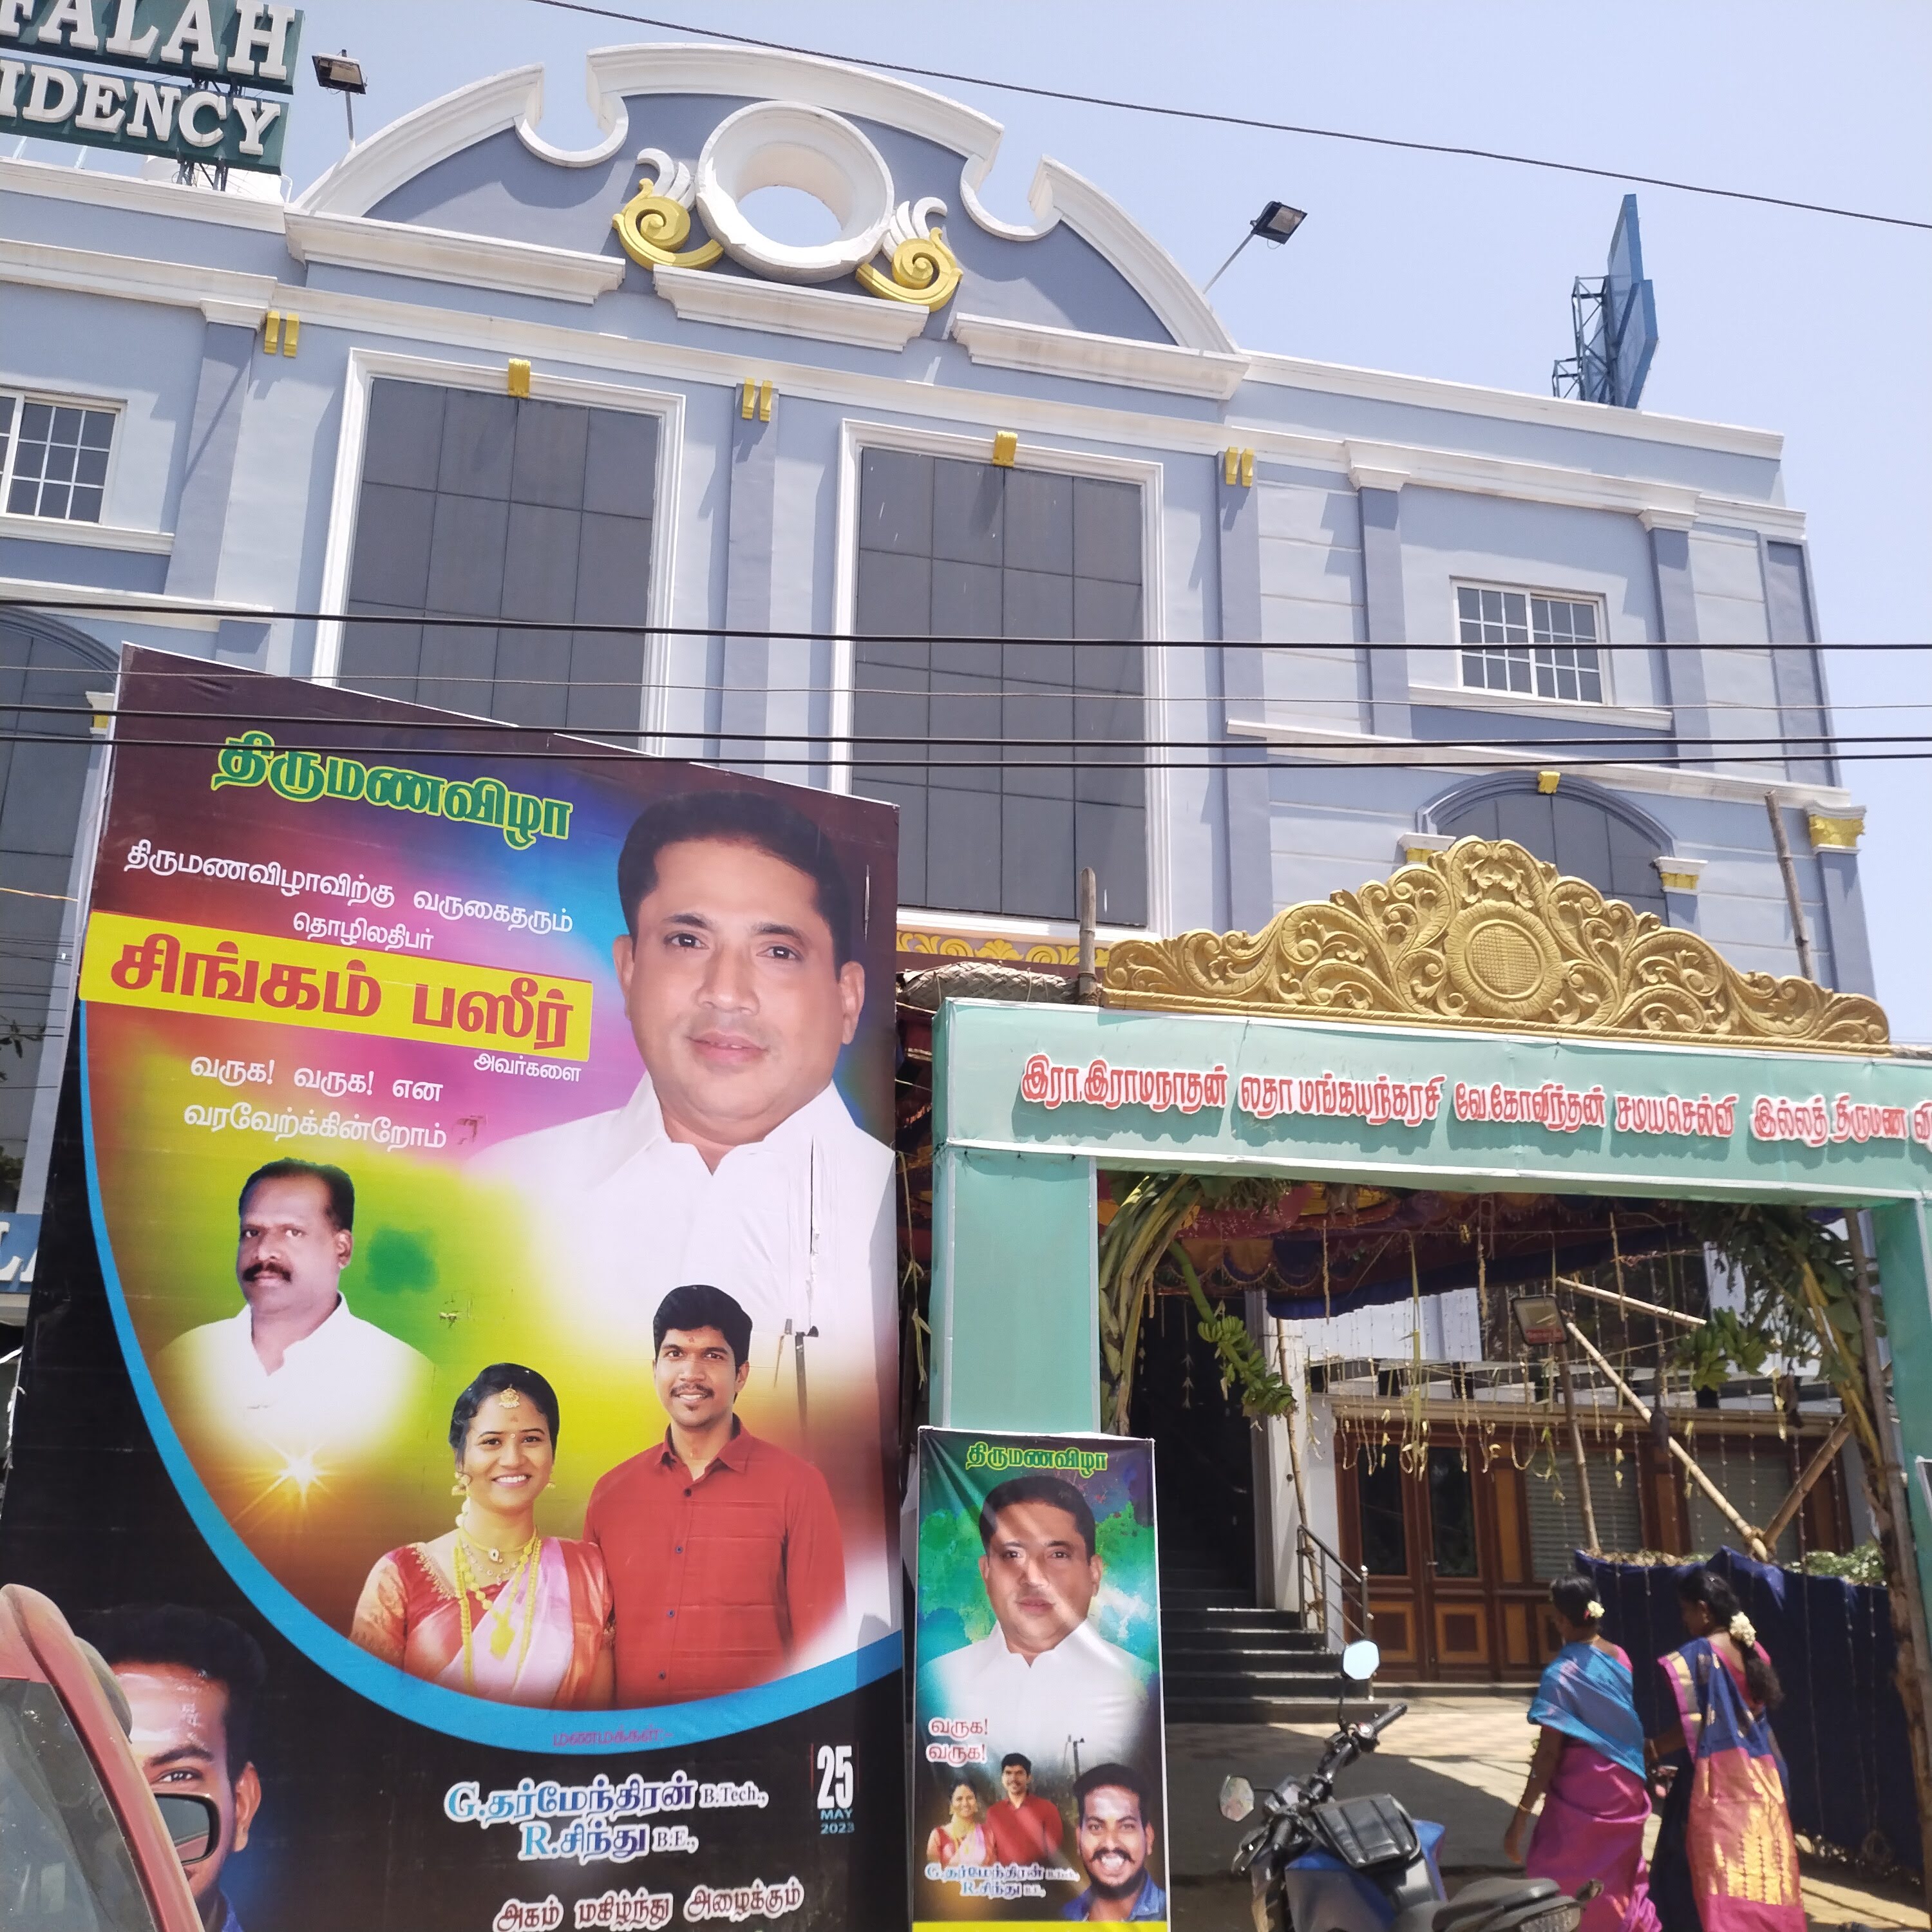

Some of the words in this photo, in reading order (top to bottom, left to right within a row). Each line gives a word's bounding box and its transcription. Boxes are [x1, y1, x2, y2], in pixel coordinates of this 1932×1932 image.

[211, 730, 573, 850] திருமணவிழா
[124, 838, 395, 909] திருமணவிழாவிற்கு
[413, 889, 573, 935] வருகைதரும்
[293, 911, 434, 951] தொழிலதிபர்
[110, 933, 382, 1018] சிங்கம்
[412, 976, 575, 1051] பஸீர்
[190, 1056, 275, 1086] வருக!
[294, 1067, 374, 1097] வருக!
[392, 1079, 444, 1102] என
[473, 1052, 582, 1083] அவர்களை
[184, 1102, 448, 1152] வரவேற்க்கின்றோம்
[965, 1441, 1108, 1479] திருமணவிழா
[928, 1718, 989, 1739] வருக!
[817, 1745, 854, 1810] 25
[925, 1743, 987, 1767] வருக!
[444, 1770, 698, 1829] G.தர்மேந்திரன்
[820, 1808, 853, 1821] MAY
[518, 1817, 650, 1866] R.சிந்து
[820, 1821, 855, 1835] 2023
[493, 1894, 564, 1932] அகம்
[574, 1887, 674, 1931] மகிழ்ந்து
[683, 1875, 805, 1922] அழைக்கும்
